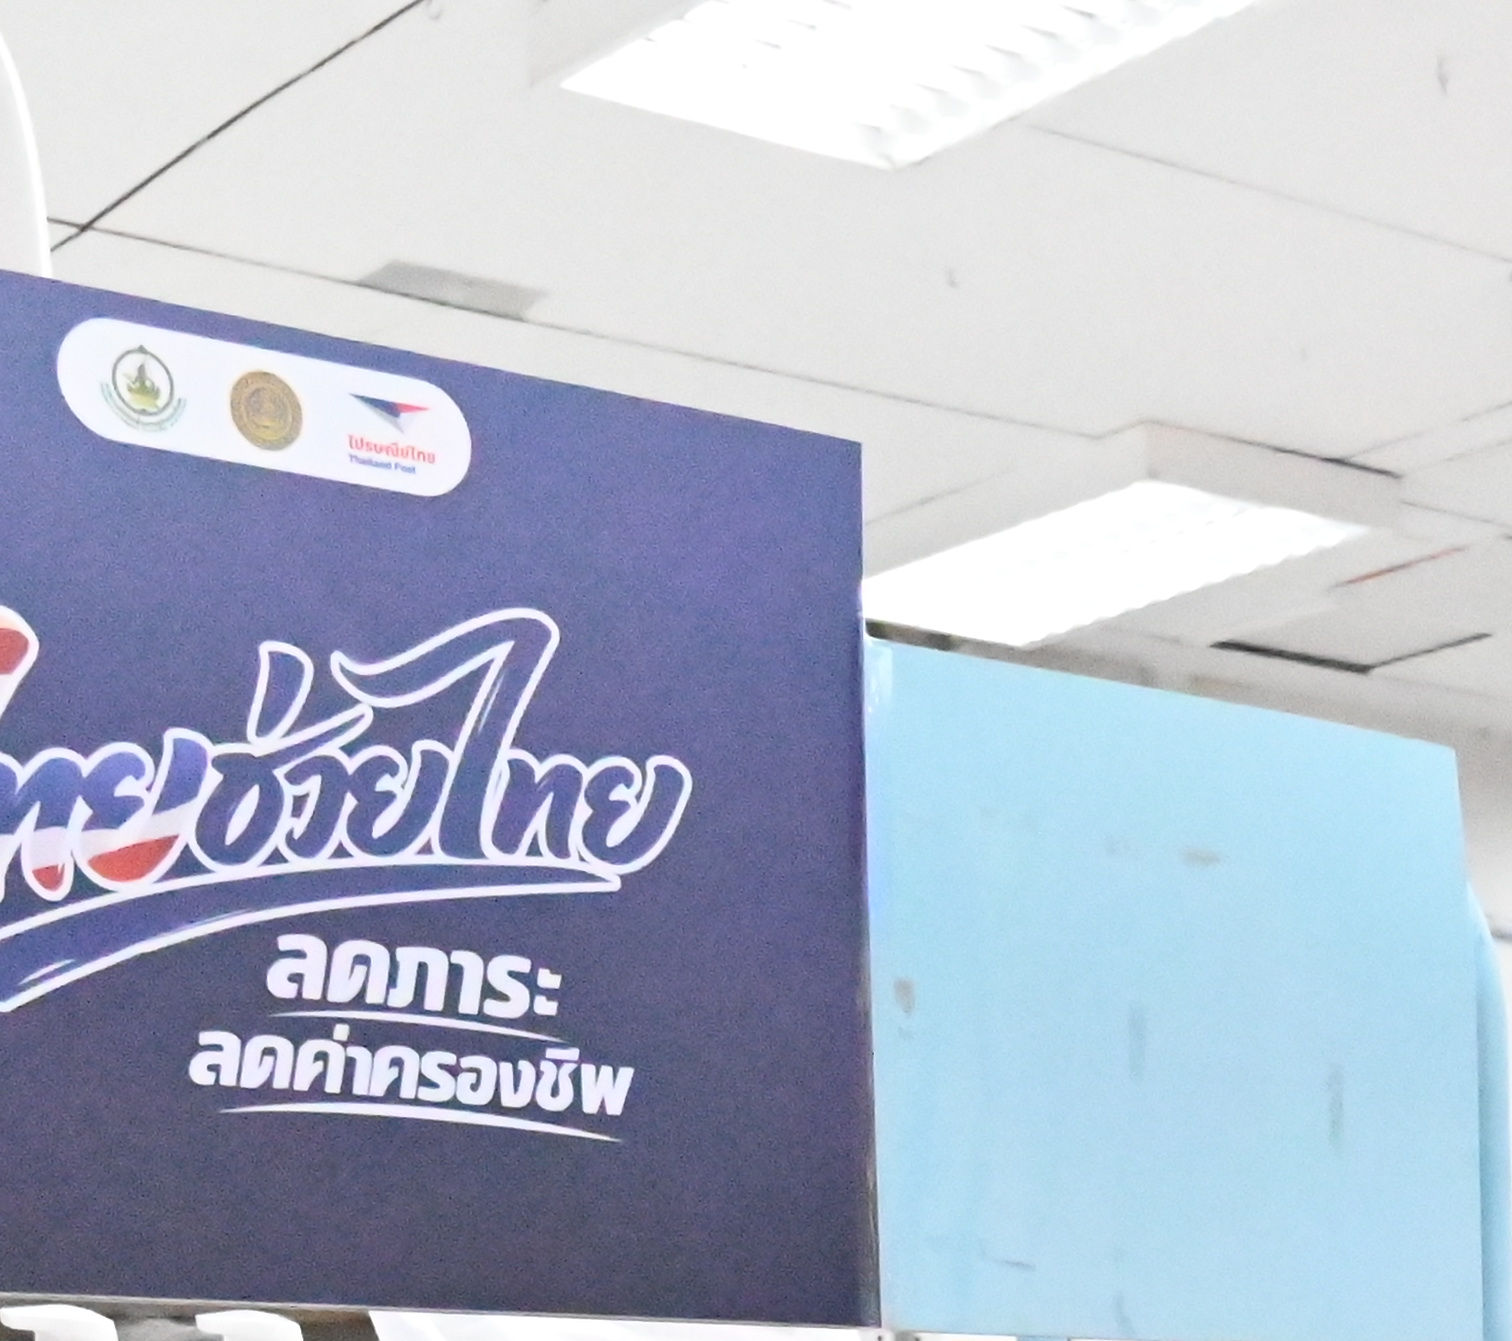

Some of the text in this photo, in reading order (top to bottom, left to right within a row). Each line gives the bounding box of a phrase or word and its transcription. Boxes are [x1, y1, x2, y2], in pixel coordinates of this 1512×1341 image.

[264, 930, 562, 1021] ลดภาระ
[188, 1022, 634, 1120] ลดค่าครองชีพ
